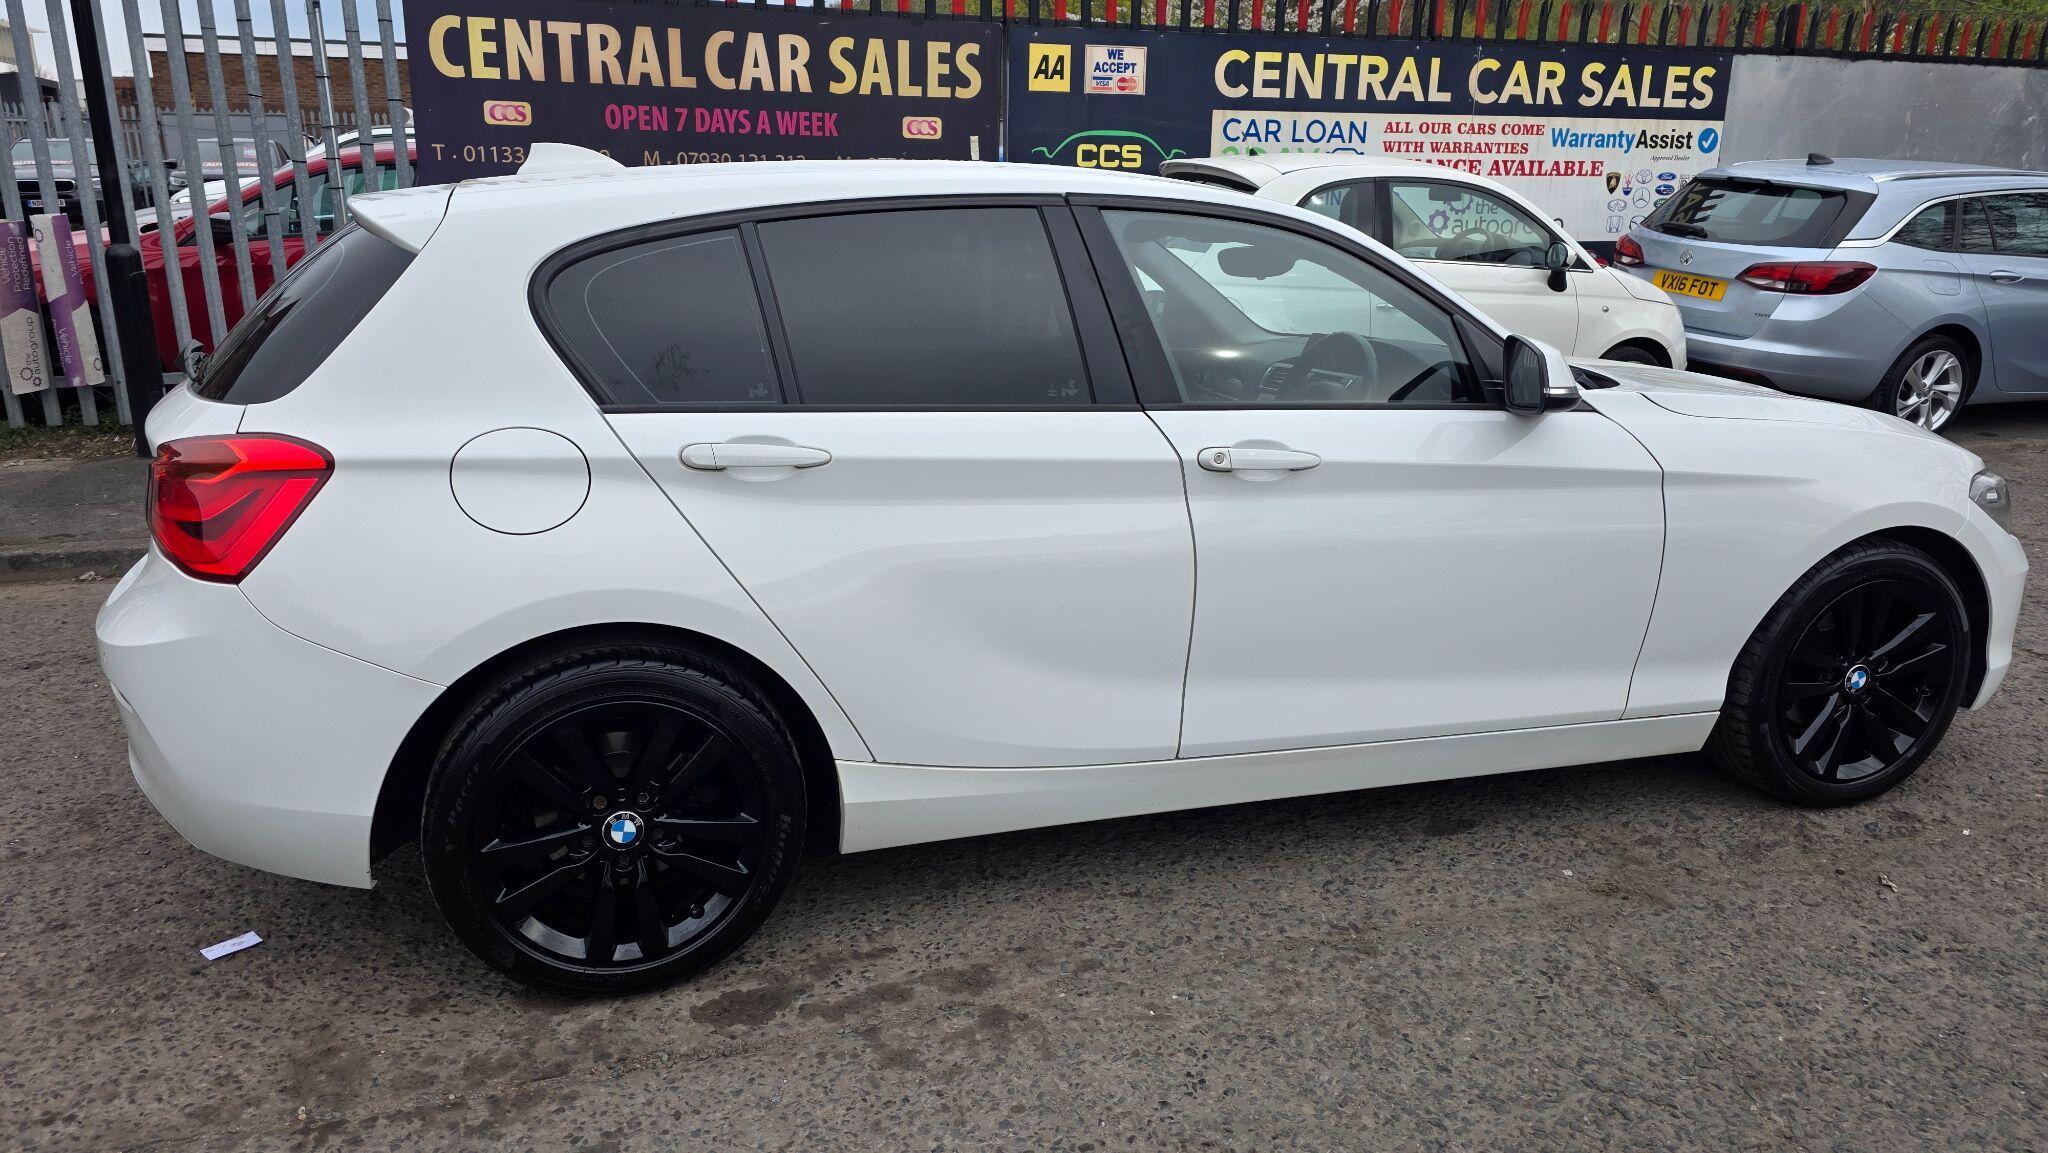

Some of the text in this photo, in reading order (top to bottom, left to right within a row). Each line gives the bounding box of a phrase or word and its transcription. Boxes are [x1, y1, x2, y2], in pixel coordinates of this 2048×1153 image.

[428, 14, 982, 99] CENTRAL CAR SALES
[1033, 54, 1065, 80] AA
[1107, 48, 1125, 60] WE
[1093, 61, 1137, 74] ACCEPT
[1214, 49, 1717, 110] CENTRAL CAR SALES
[605, 103, 839, 137] OPEN 7 DAYS A WEEK
[1222, 117, 1368, 144] CAR LOAN
[1384, 121, 1545, 136] ALL OUR CARS COME
[1077, 144, 1142, 168] CCS
[1382, 140, 1529, 154] WITH WARRANTIES
[1487, 159, 1605, 177] AVAILABLE
[8, 236, 23, 292] Protection
[15, 236, 31, 291] Redefined
[64, 239, 78, 278] Vehicle
[1660, 273, 1719, 297] VX16 FOT
[26, 316, 41, 376] autogroup
